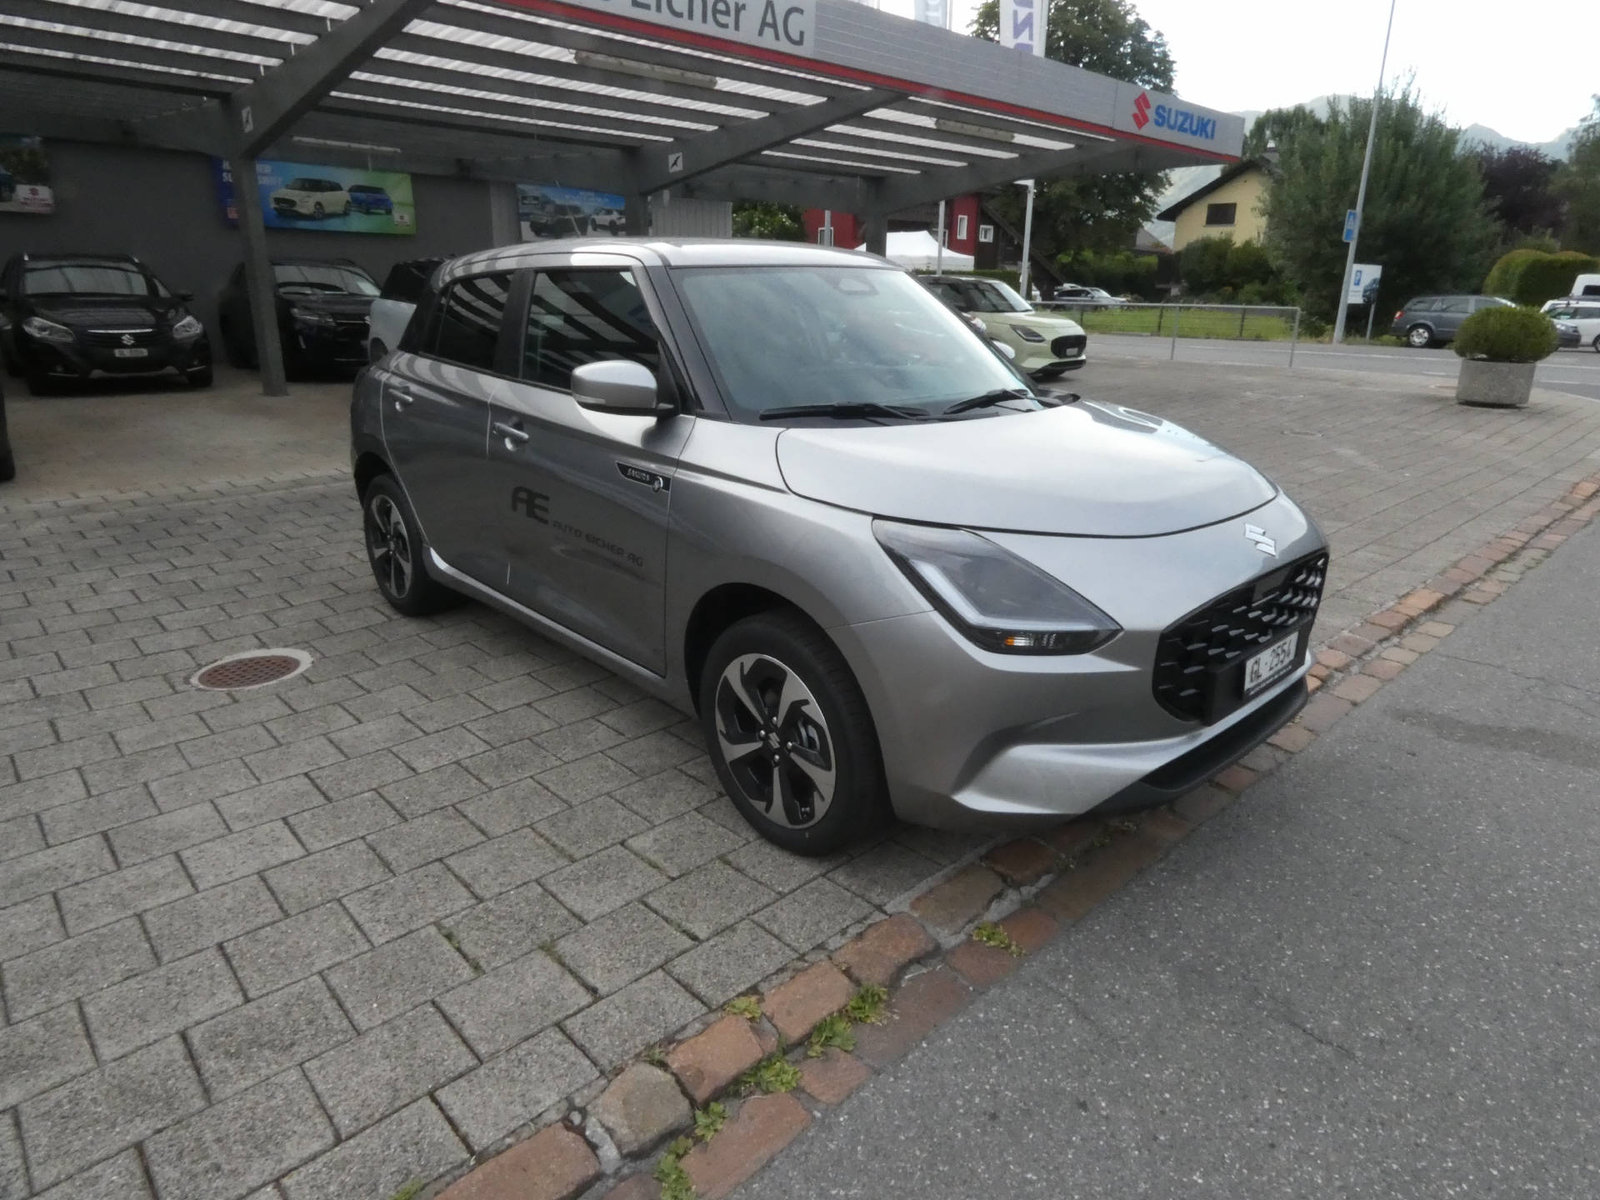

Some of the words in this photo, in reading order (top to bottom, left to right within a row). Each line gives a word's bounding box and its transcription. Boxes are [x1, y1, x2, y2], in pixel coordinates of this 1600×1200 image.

[631, 0, 746, 31] cher
[758, 0, 805, 46] AG
[1154, 104, 1216, 140] SUZUKI
